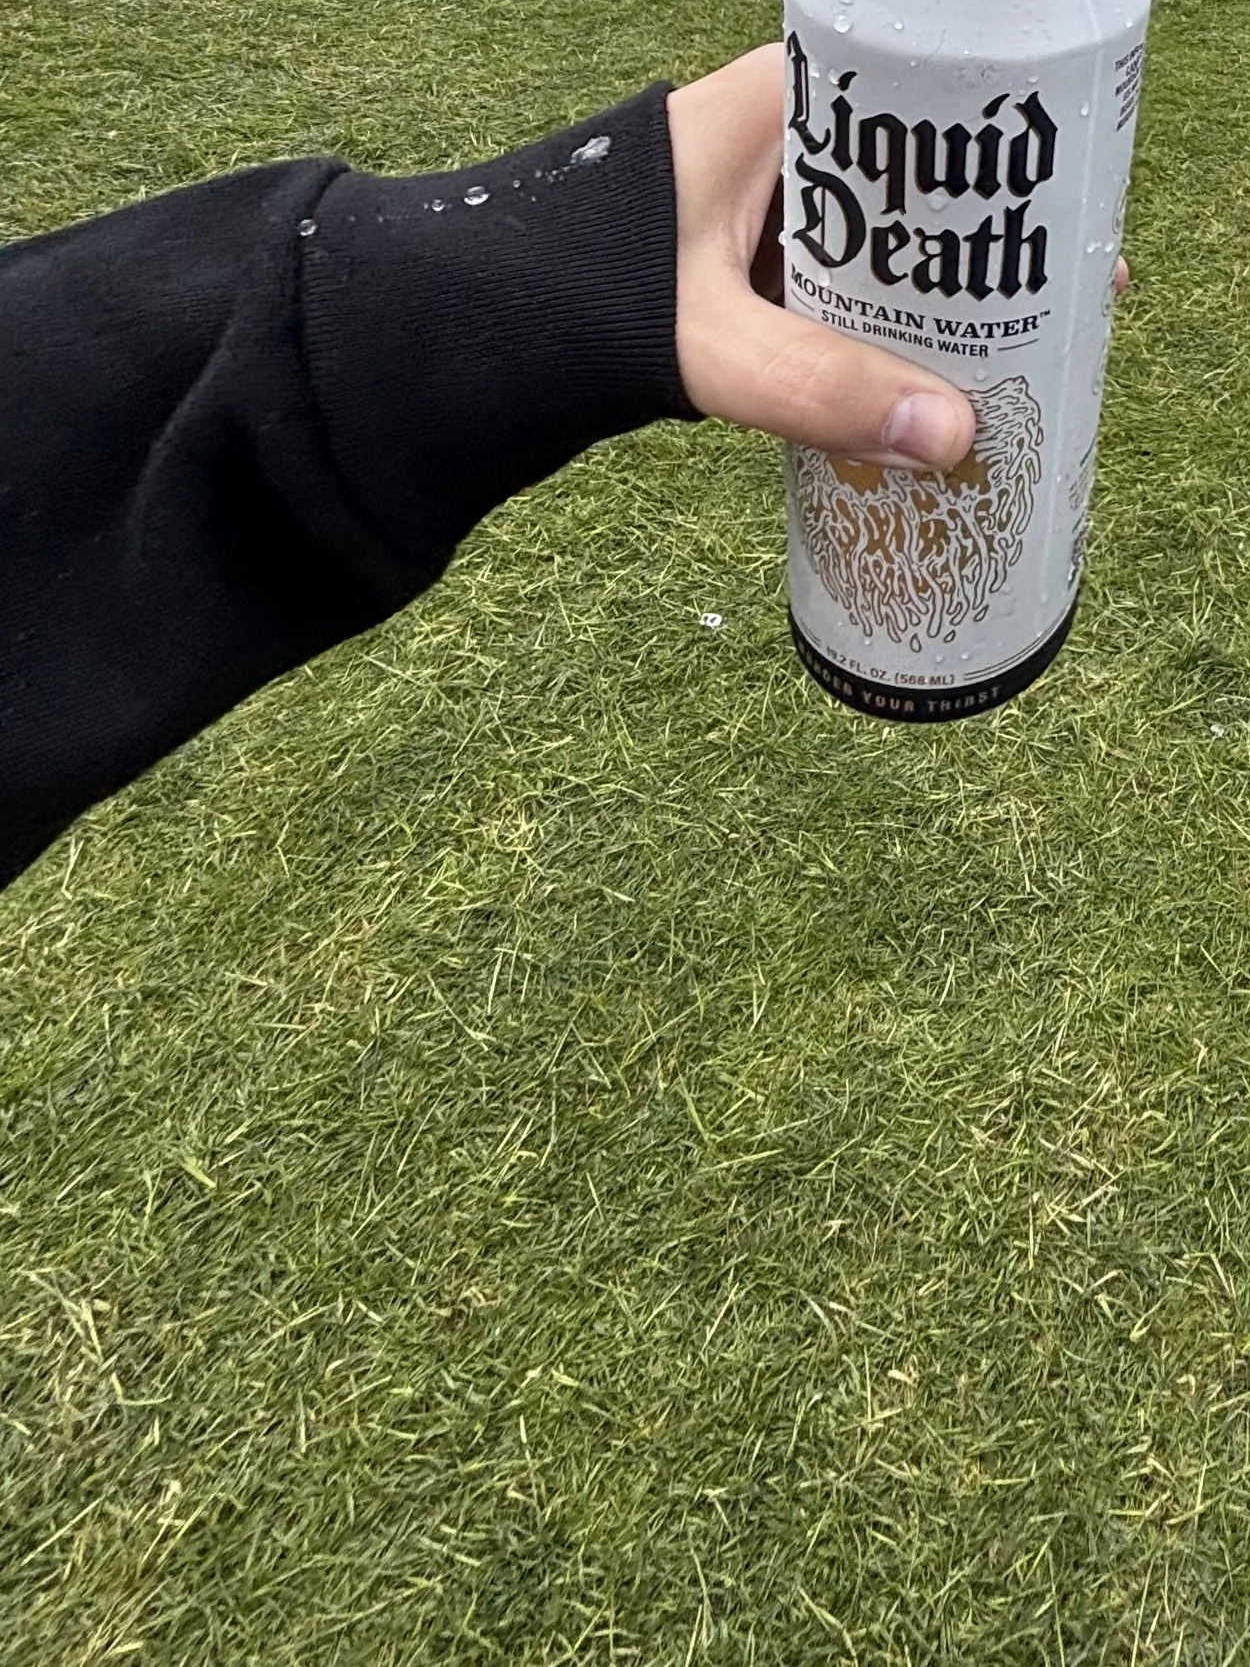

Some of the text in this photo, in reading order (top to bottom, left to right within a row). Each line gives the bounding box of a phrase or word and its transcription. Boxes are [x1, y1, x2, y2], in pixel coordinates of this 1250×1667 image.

[786, 30, 1058, 215] Liquid
[792, 152, 1048, 301] Death
[791, 262, 926, 330] MOUNTAIN
[821, 309, 989, 358] STILL DRINKING WATER
[862, 691, 915, 713] YOUR
[927, 685, 1004, 713] THIRST
[894, 671, 927, 685] (568
[929, 674, 955, 686] ML)
